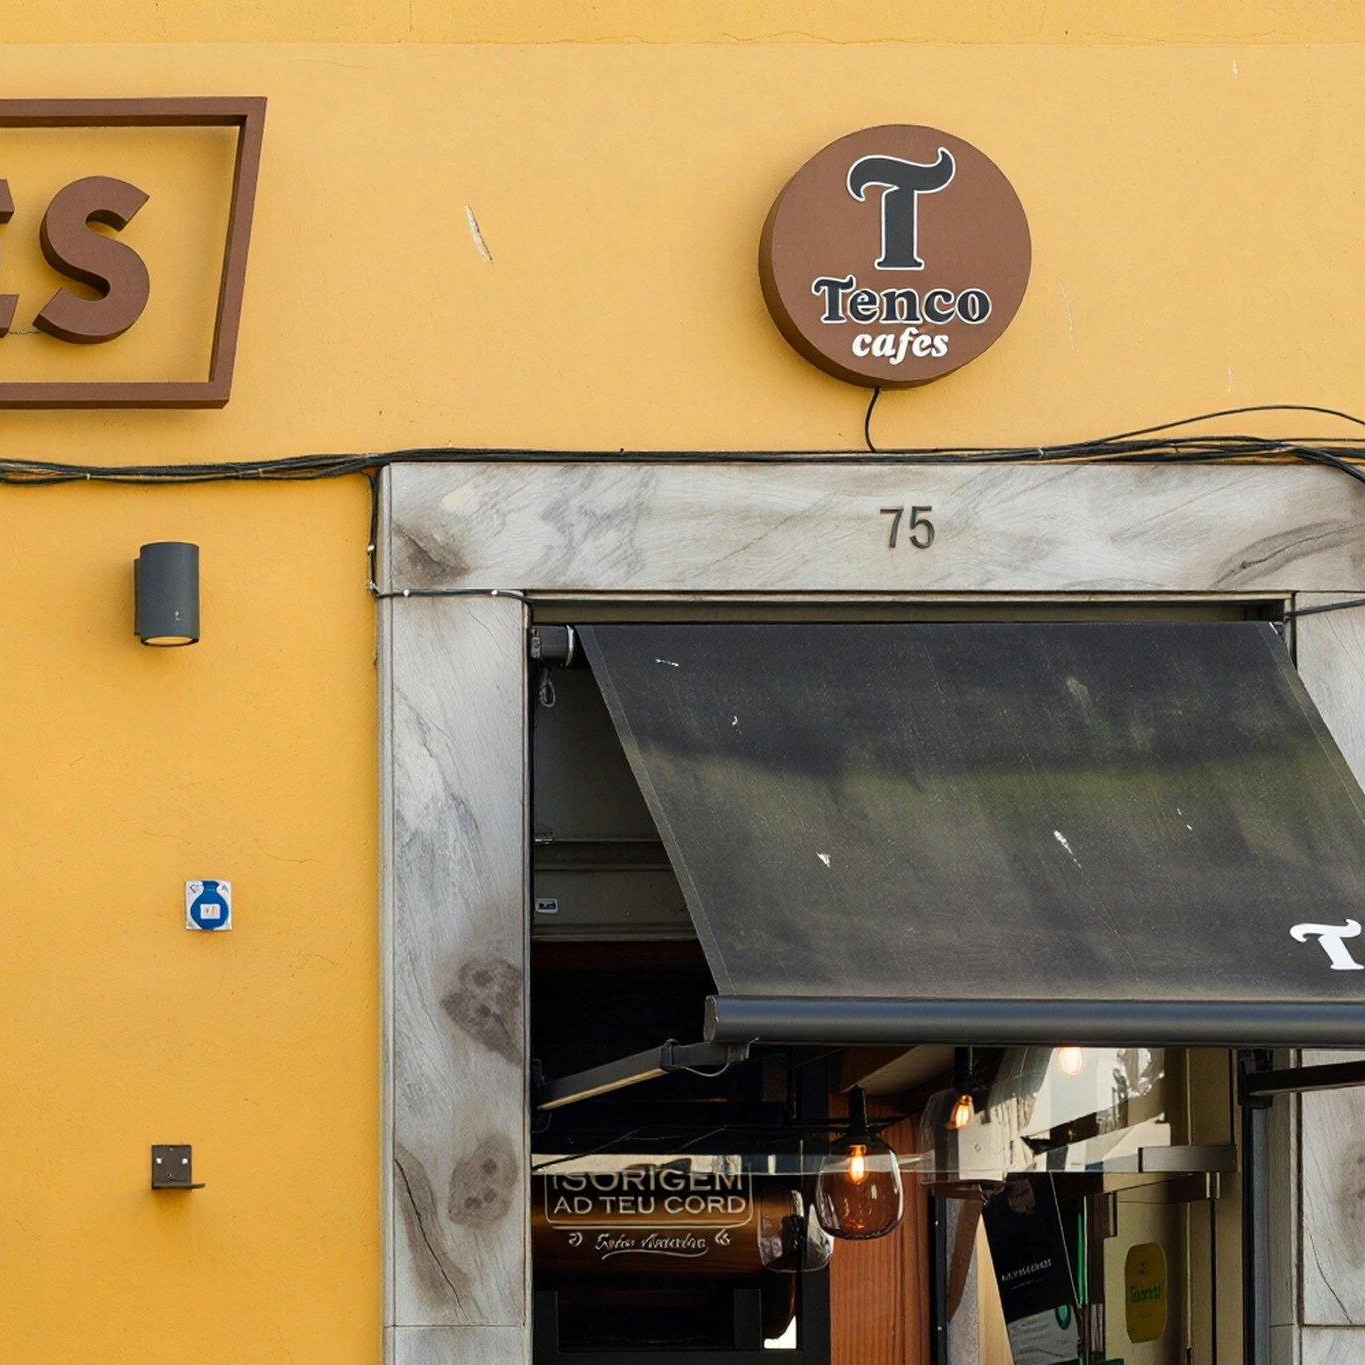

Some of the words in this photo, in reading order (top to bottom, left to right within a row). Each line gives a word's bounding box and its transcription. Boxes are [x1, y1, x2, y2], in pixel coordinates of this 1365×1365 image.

[847, 147, 956, 271] T
[812, 275, 992, 325] Tenco
[852, 326, 949, 364] cafes
[879, 505, 936, 549] 75
[599, 1195, 655, 1215] TEU
[663, 1194, 747, 1214] CORD
